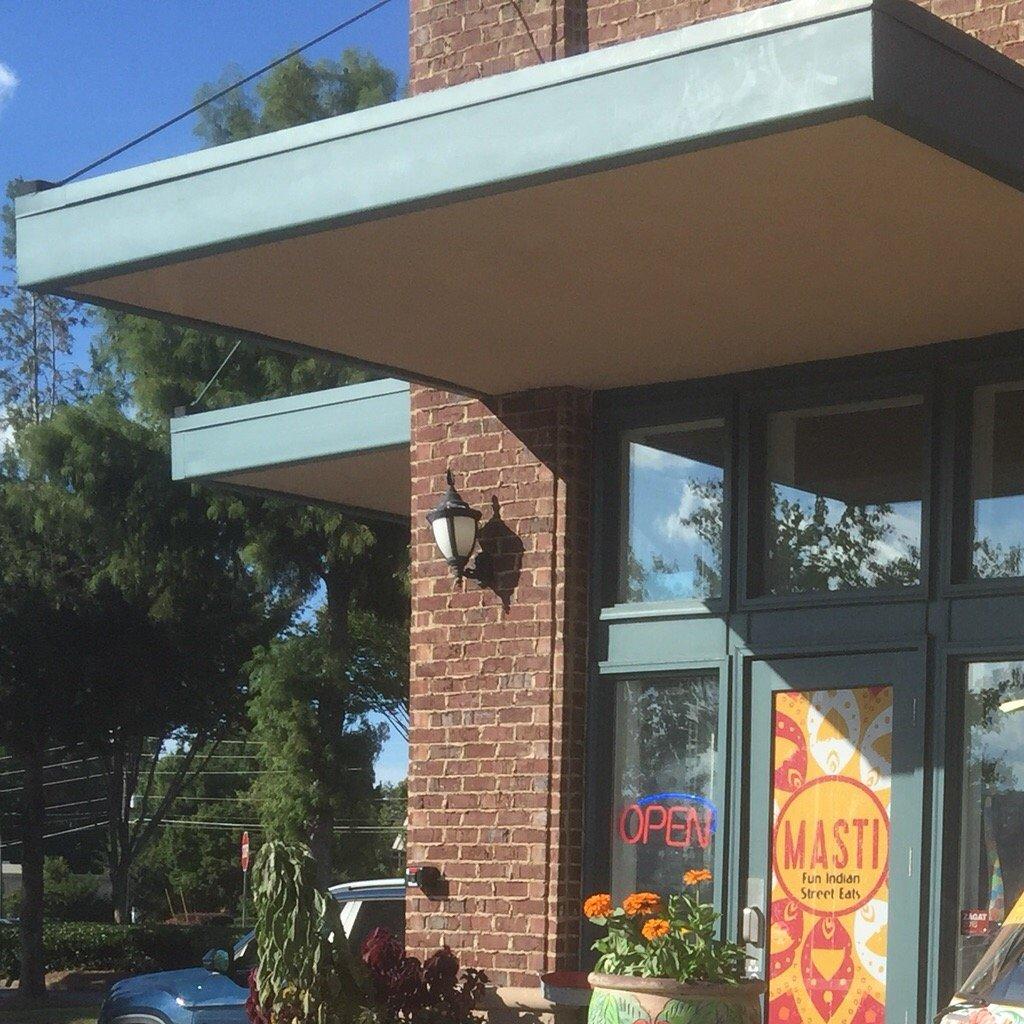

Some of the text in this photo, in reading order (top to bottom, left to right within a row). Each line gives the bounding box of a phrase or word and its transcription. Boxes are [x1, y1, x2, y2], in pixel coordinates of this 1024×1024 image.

[618, 802, 713, 849] OPEN
[784, 819, 879, 870] MASTI
[802, 872, 860, 884] Fun Indian
[801, 887, 861, 899] Street Eats
[963, 913, 987, 921] ZAGAT
